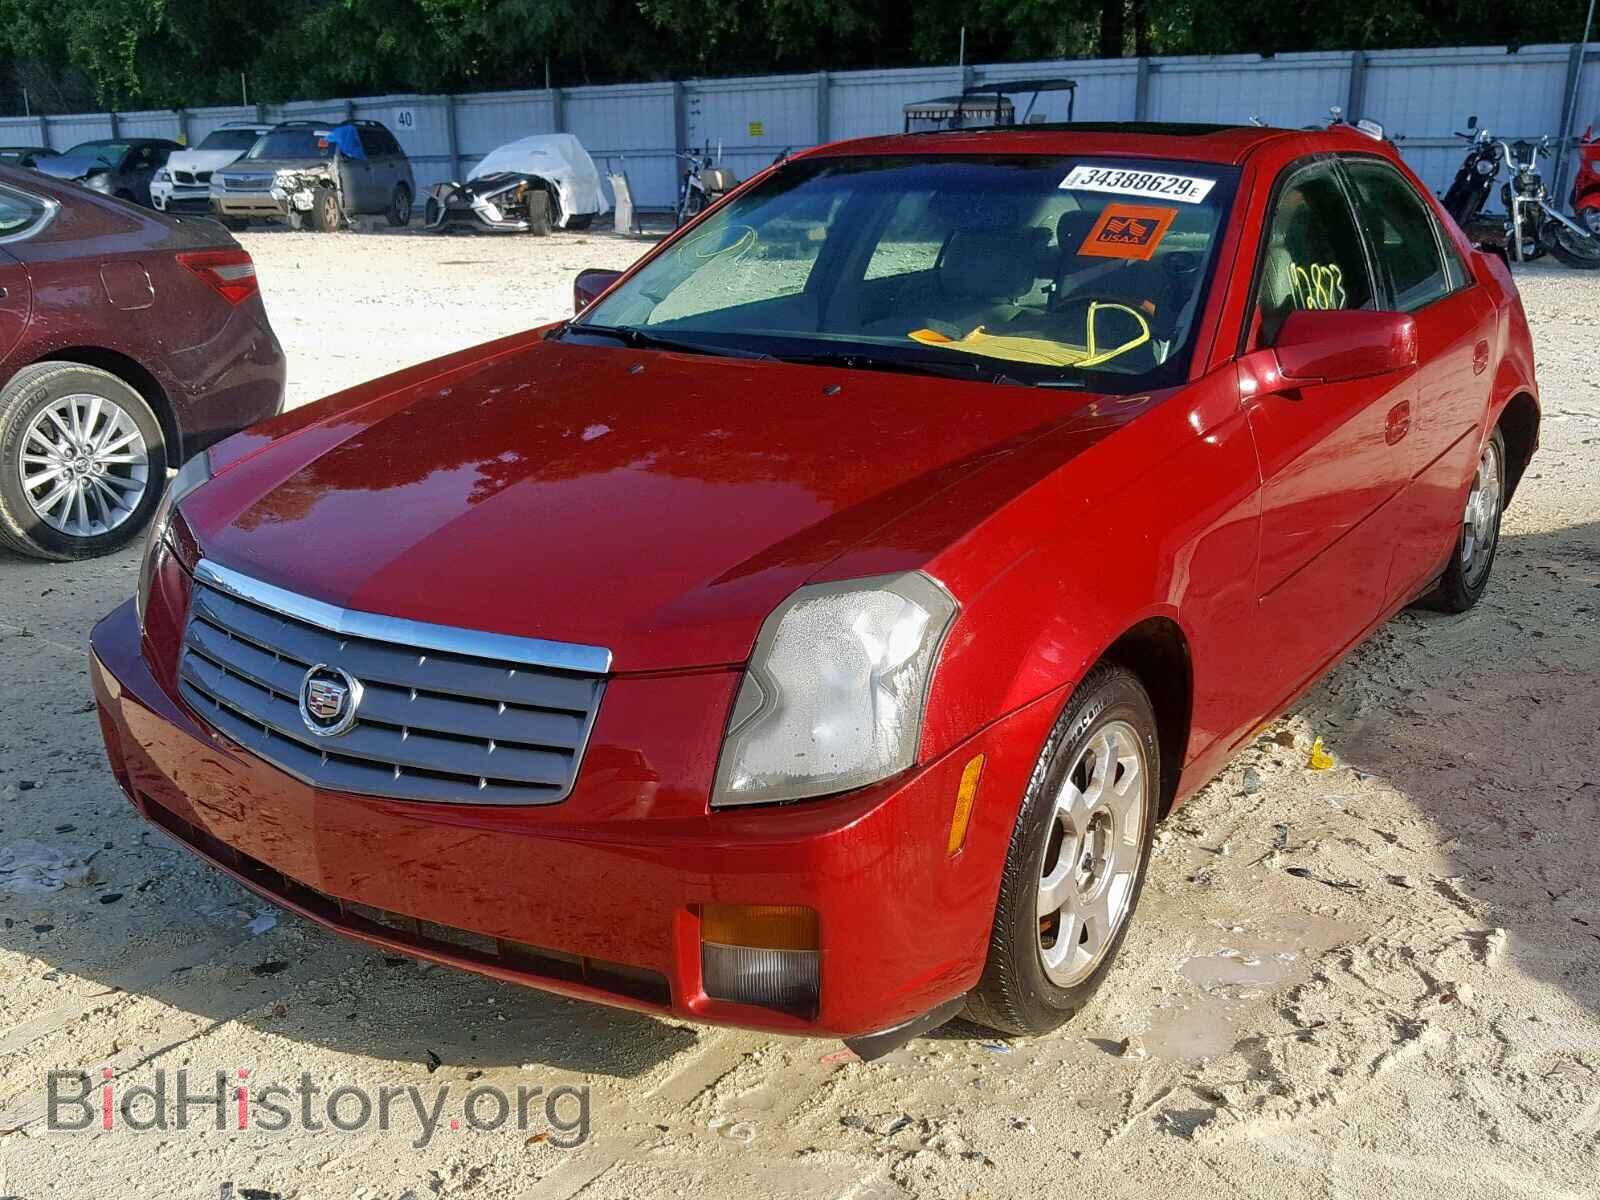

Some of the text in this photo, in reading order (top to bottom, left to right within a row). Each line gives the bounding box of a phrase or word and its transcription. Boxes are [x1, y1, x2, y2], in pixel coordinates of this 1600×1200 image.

[398, 111, 412, 127] 40
[1080, 169, 1194, 195] 34388629
[1100, 232, 1139, 242] USAA
